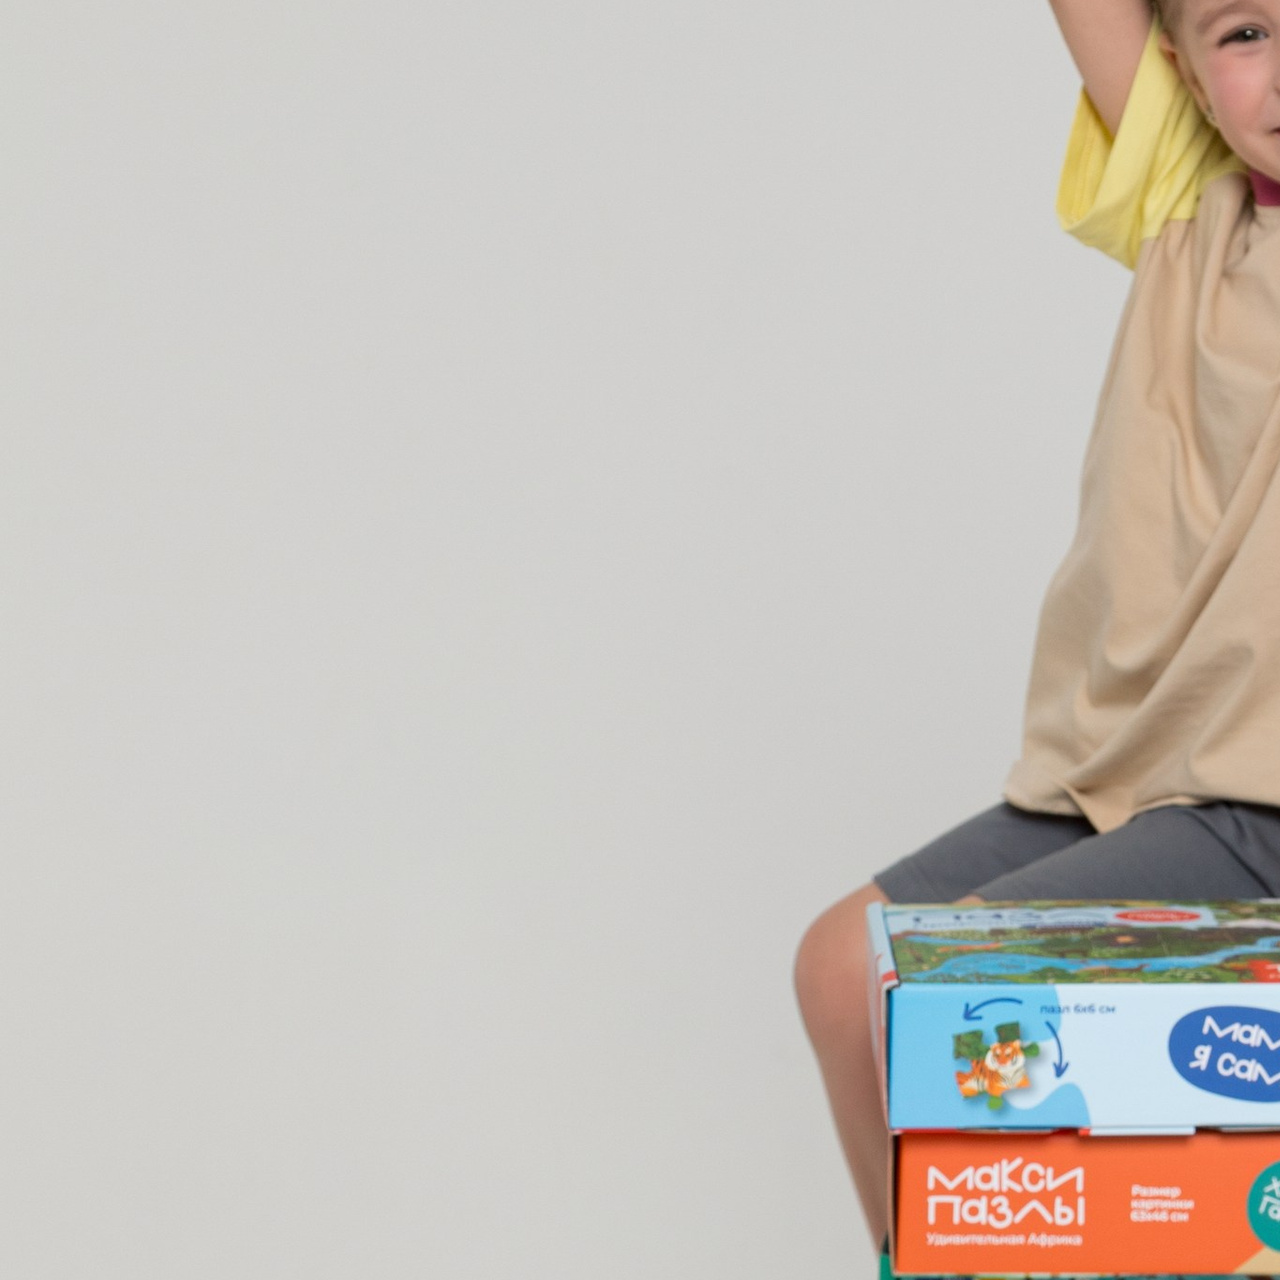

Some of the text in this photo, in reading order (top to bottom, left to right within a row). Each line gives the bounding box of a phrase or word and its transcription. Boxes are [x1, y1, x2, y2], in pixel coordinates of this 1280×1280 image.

[1189, 1043, 1212, 1071] я
[1131, 1184, 1182, 1199] Размер
[926, 1232, 1083, 1247] Удивительная Африка
